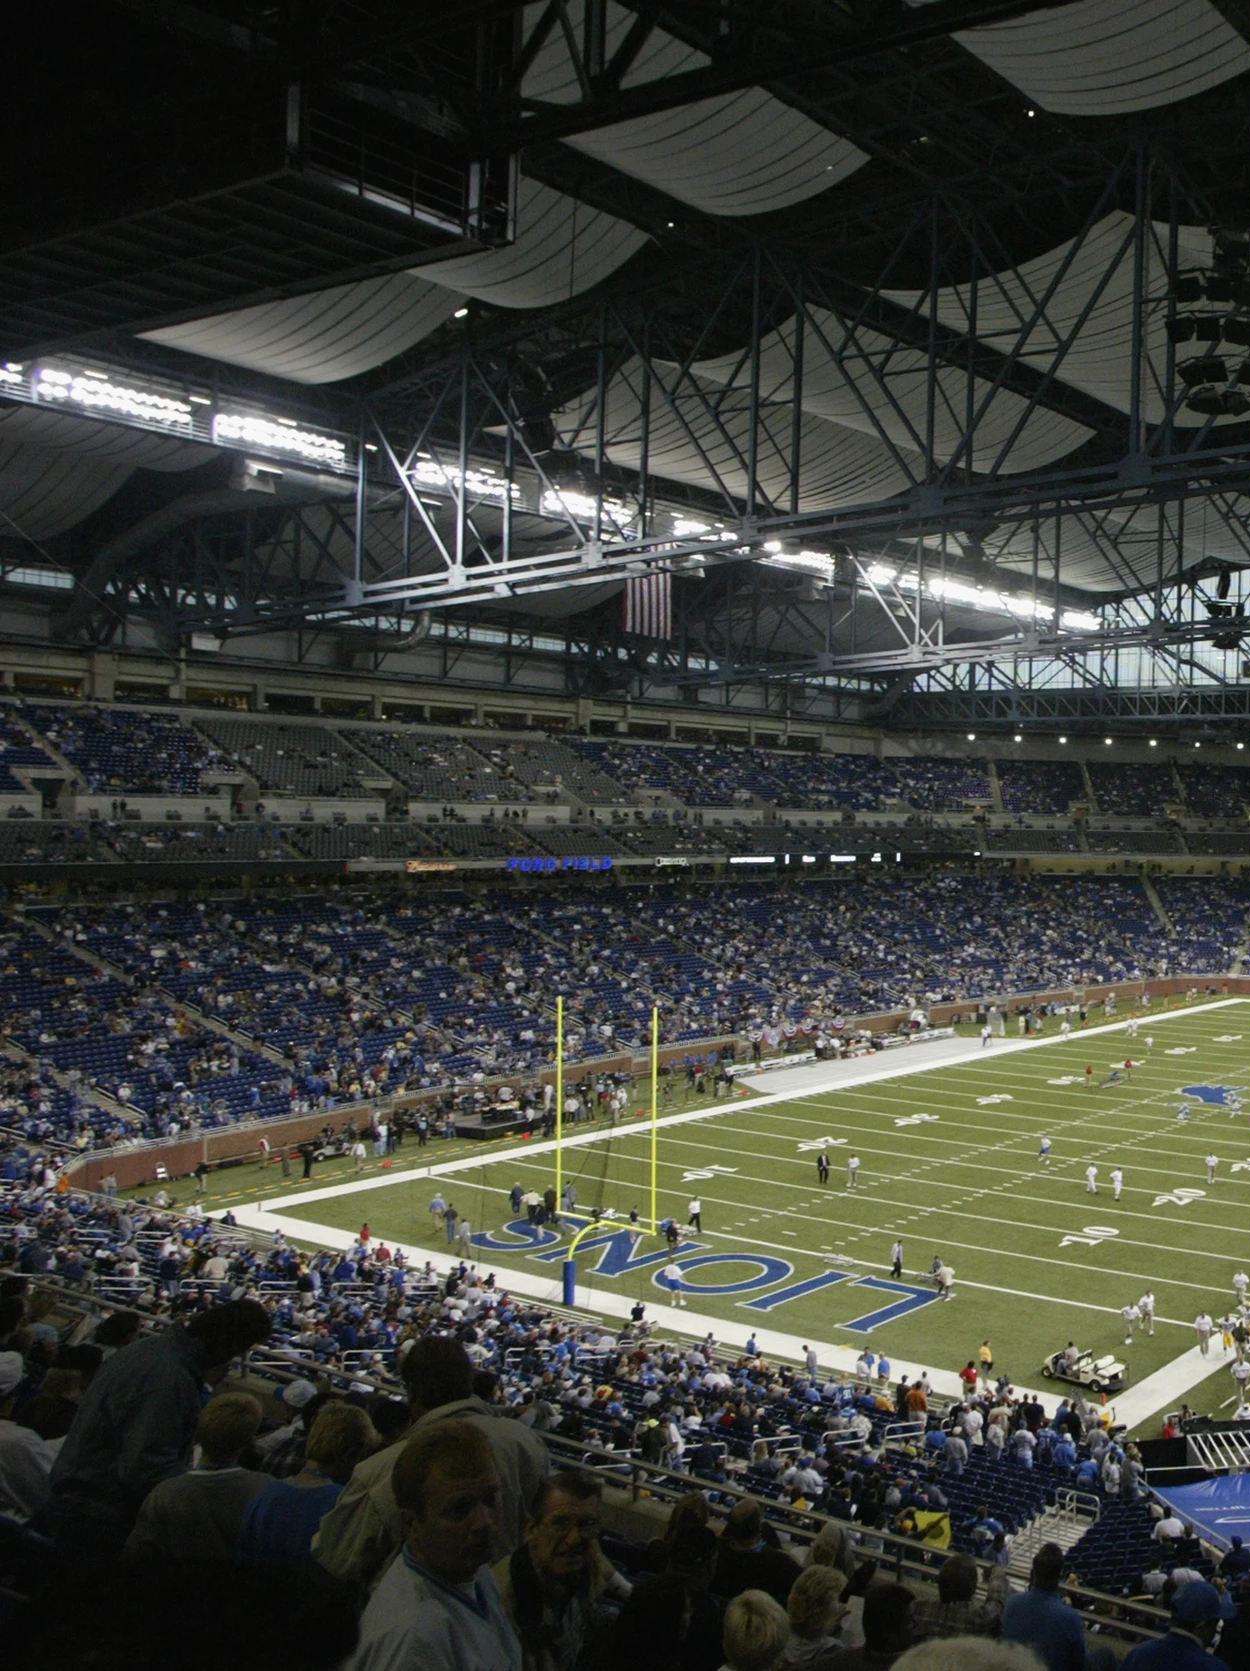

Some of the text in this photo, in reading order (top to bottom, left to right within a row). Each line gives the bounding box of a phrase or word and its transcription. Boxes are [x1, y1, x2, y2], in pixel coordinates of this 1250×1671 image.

[507, 856, 613, 872] FORD FIELD
[682, 1164, 739, 1181] 10
[1152, 1188, 1207, 1206] 20
[1060, 1226, 1120, 1247] 10
[470, 1216, 956, 1334] LIONS
